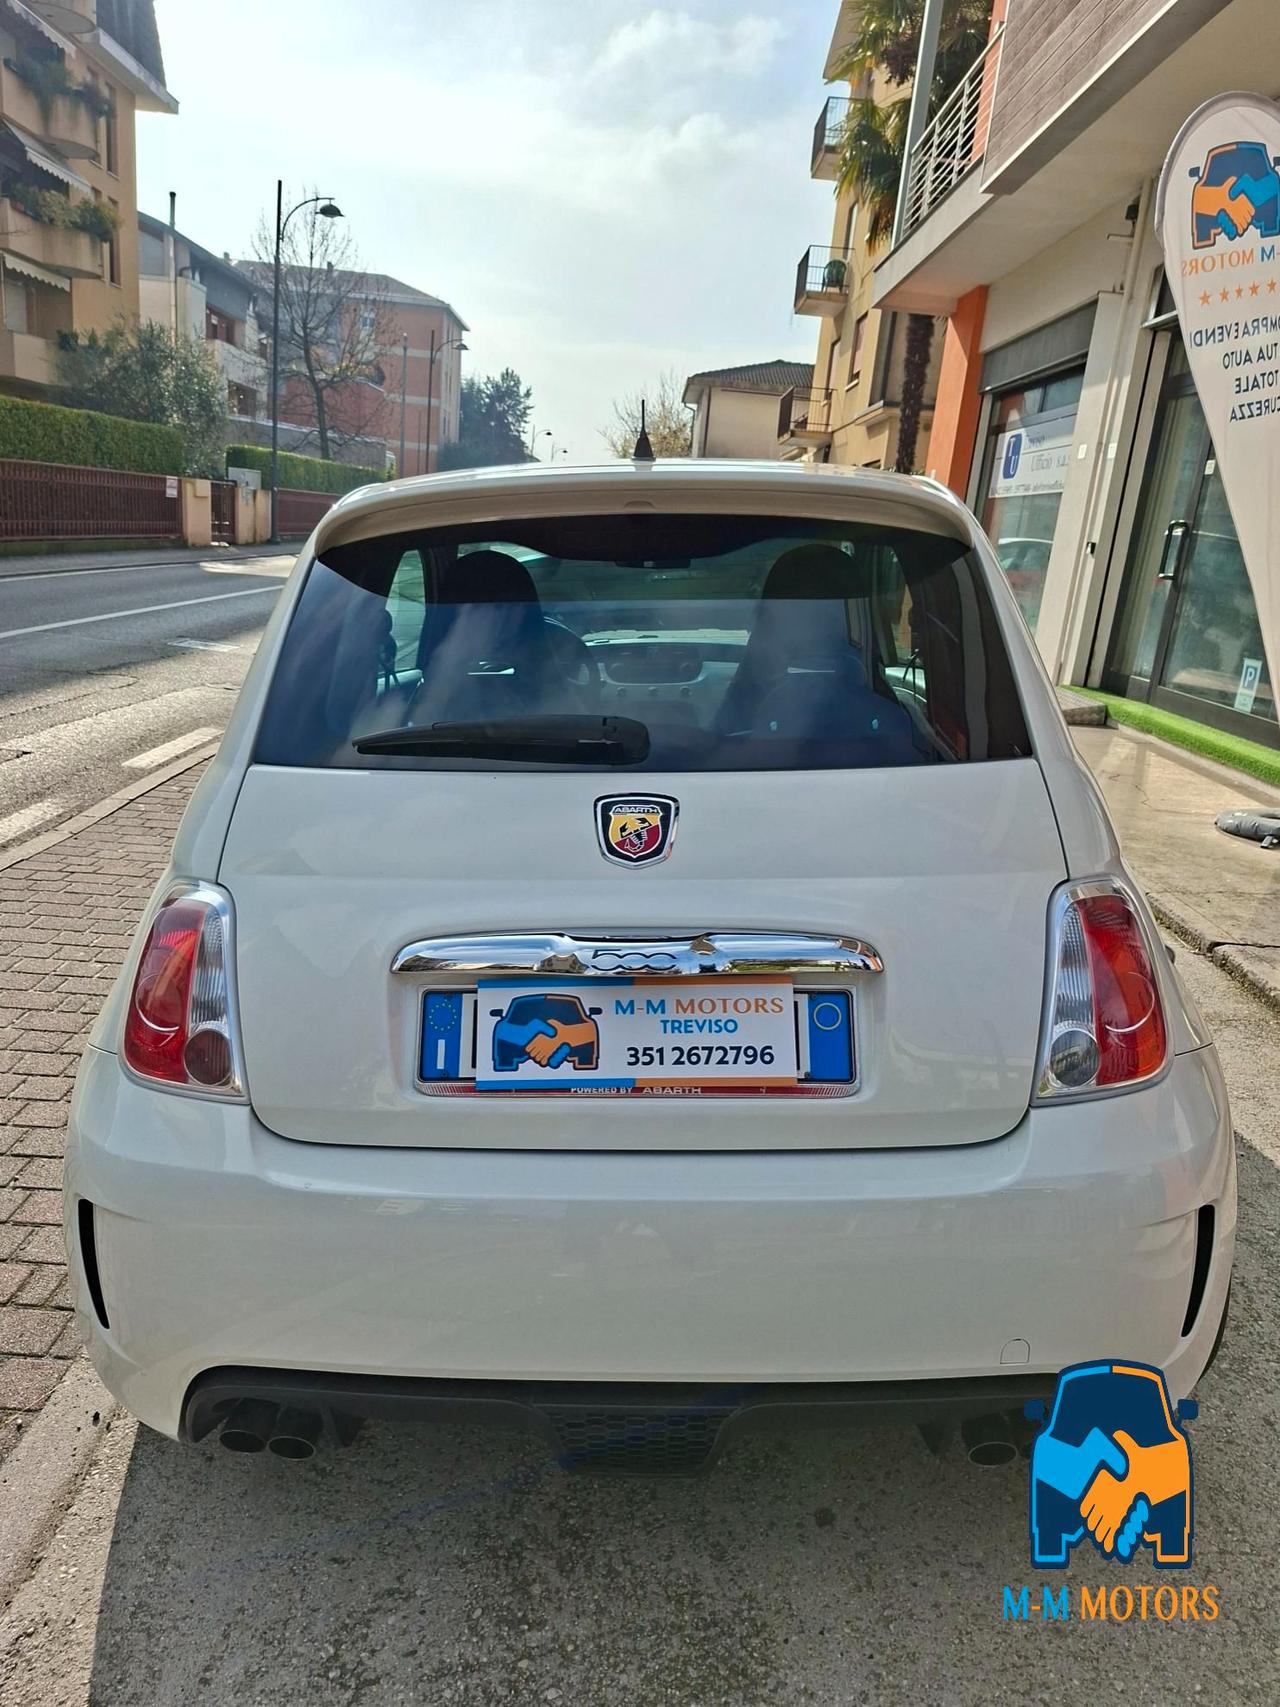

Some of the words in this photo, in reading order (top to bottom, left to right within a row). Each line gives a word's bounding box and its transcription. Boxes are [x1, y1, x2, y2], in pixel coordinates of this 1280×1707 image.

[615, 999, 666, 1015] M-M
[675, 997, 784, 1014] MOTORS
[660, 1018, 738, 1034] TREVISO
[642, 1086, 702, 1095] ABARTH
